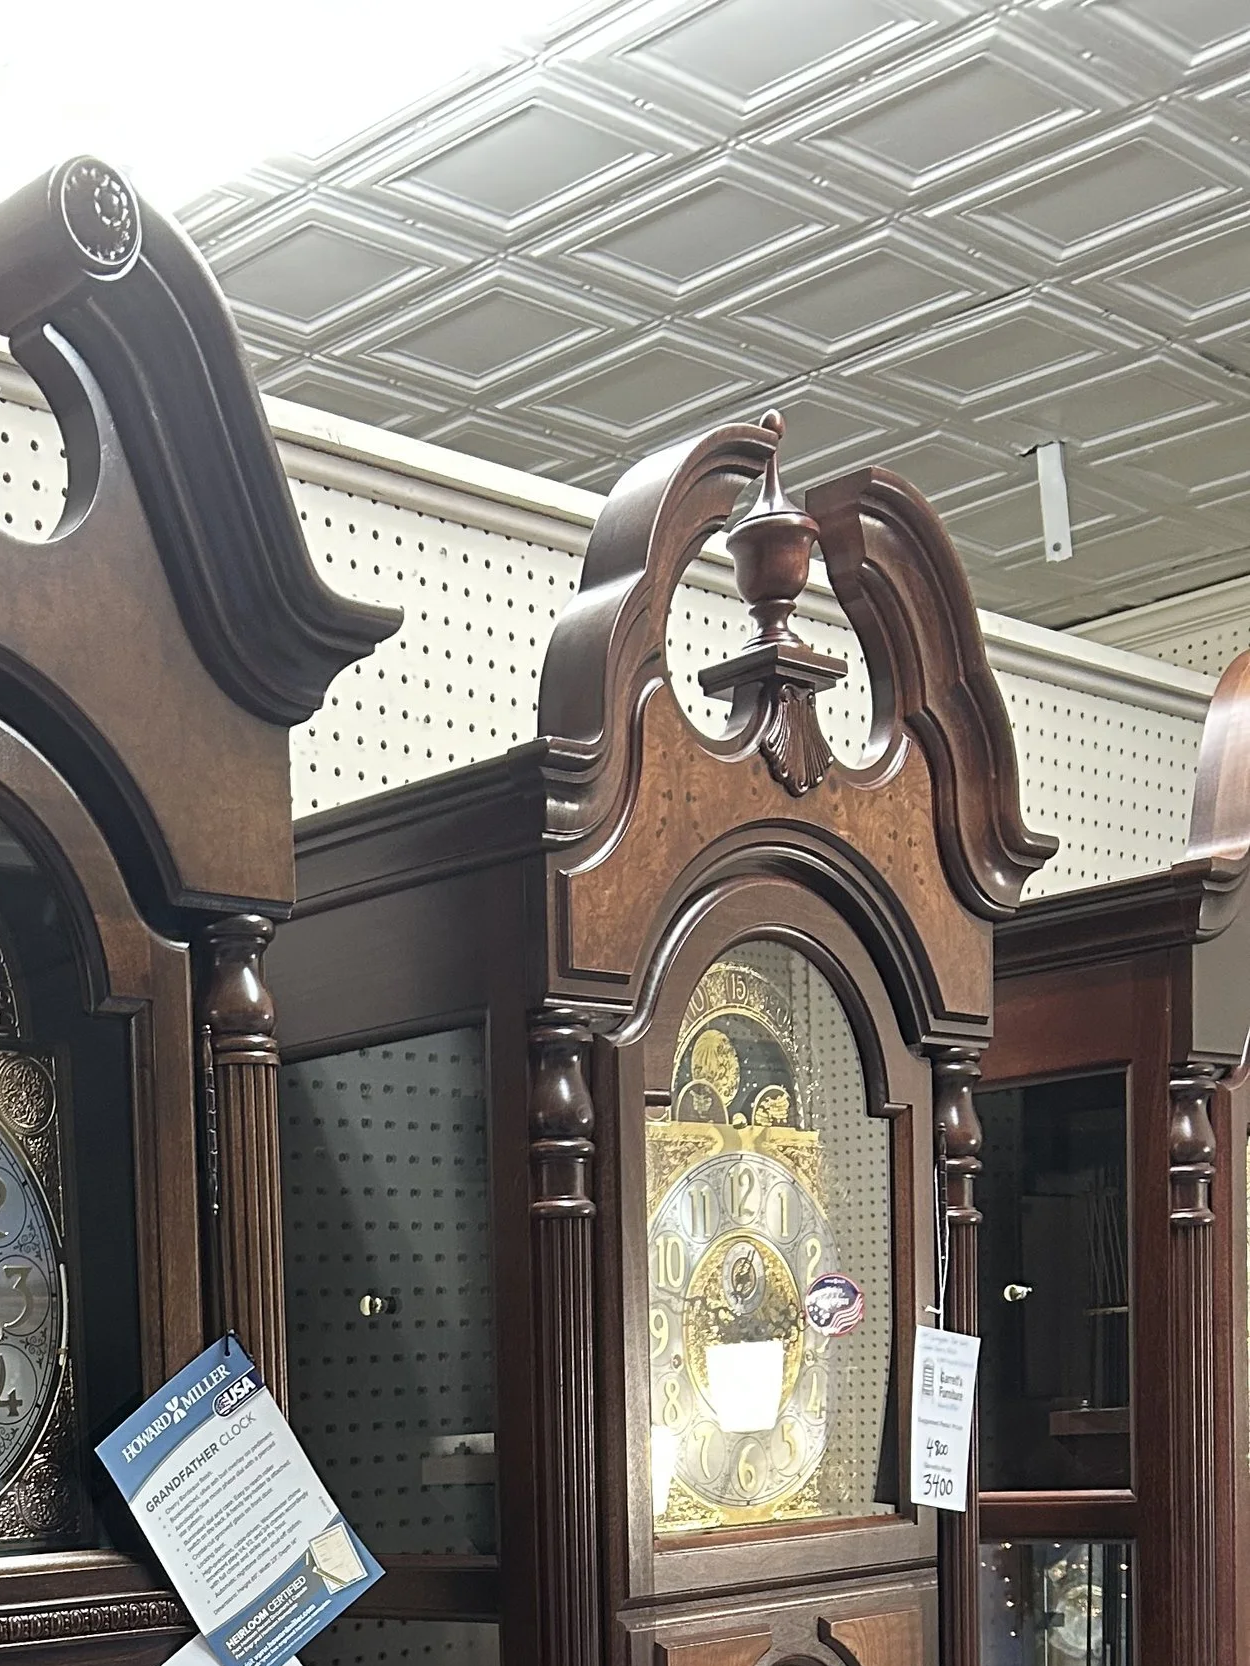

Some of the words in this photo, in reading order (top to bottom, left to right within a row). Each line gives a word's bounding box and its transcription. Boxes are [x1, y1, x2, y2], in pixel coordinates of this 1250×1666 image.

[730, 974, 746, 1000] 15
[691, 1186, 711, 1237] 11
[730, 1164, 753, 1218] 12
[779, 1187, 787, 1237] 1
[656, 1237, 682, 1287] 10
[806, 1238, 822, 1283] 2
[2, 1265, 32, 1328] 3
[651, 1309, 669, 1358] 9
[120, 1410, 174, 1463] HOWARD
[179, 1362, 231, 1410] MILLER
[228, 1375, 257, 1405] USA
[664, 1378, 681, 1428] 8
[939, 1386, 963, 1401] Furniture
[144, 1441, 220, 1514] GRANDFATHER
[218, 1410, 256, 1447] CLOCK
[737, 1446, 756, 1492] 6
[926, 1437, 948, 1458] 4800
[164, 1500, 180, 1515] Cherry
[178, 1481, 200, 1502] Bordeaux
[174, 1506, 200, 1531] Astrological
[198, 1498, 209, 1509] blue
[209, 1487, 223, 1500] moon
[222, 1475, 236, 1490] phase
[235, 1466, 244, 1477] dial
[244, 1458, 254, 1469] with
[257, 1440, 275, 1459] pierced
[199, 1485, 211, 1496] olive
[228, 1455, 245, 1471] overlay
[204, 1515, 214, 1526] dial
[213, 1508, 223, 1518] and
[233, 1489, 245, 1501] Easy
[249, 1473, 263, 1487] reach
[262, 1464, 274, 1476] roller
[923, 1474, 953, 1498] 3400
[186, 1537, 201, 1552] switch
[200, 1532, 207, 1540] on
[206, 1526, 215, 1534] the
[229, 1500, 244, 1513] handy
[191, 1537, 215, 1560] Crystal-cut
[214, 1521, 233, 1541] grooved
[232, 1511, 245, 1525] glass
[244, 1506, 251, 1514] on
[250, 1495, 262, 1508] front
[260, 1499, 287, 1524] Westminster
[287, 1487, 301, 1501] chime
[196, 1551, 215, 1569] Locking
[205, 1560, 228, 1583] movement
[227, 1551, 239, 1564] plays
[253, 1529, 263, 1541] and
[269, 1511, 285, 1526] chimes
[284, 1491, 309, 1513] accordingly
[209, 1578, 220, 1589] with
[218, 1572, 227, 1581] full
[226, 1561, 240, 1574] chime
[239, 1552, 249, 1562] and
[248, 1542, 261, 1554] strike
[260, 1536, 268, 1544] on
[266, 1529, 275, 1538] the
[214, 1576, 236, 1597] Automatic
[236, 1558, 257, 1578] nighttime
[256, 1546, 270, 1560] chime
[236, 1578, 251, 1593] Height
[258, 1561, 271, 1574] Width
[225, 1607, 269, 1650] HEIRLOOM
[266, 1574, 307, 1613] CERTIFIED
[253, 1603, 316, 1661] www.howardmiller.com
[240, 1630, 258, 1647] Heirloom
